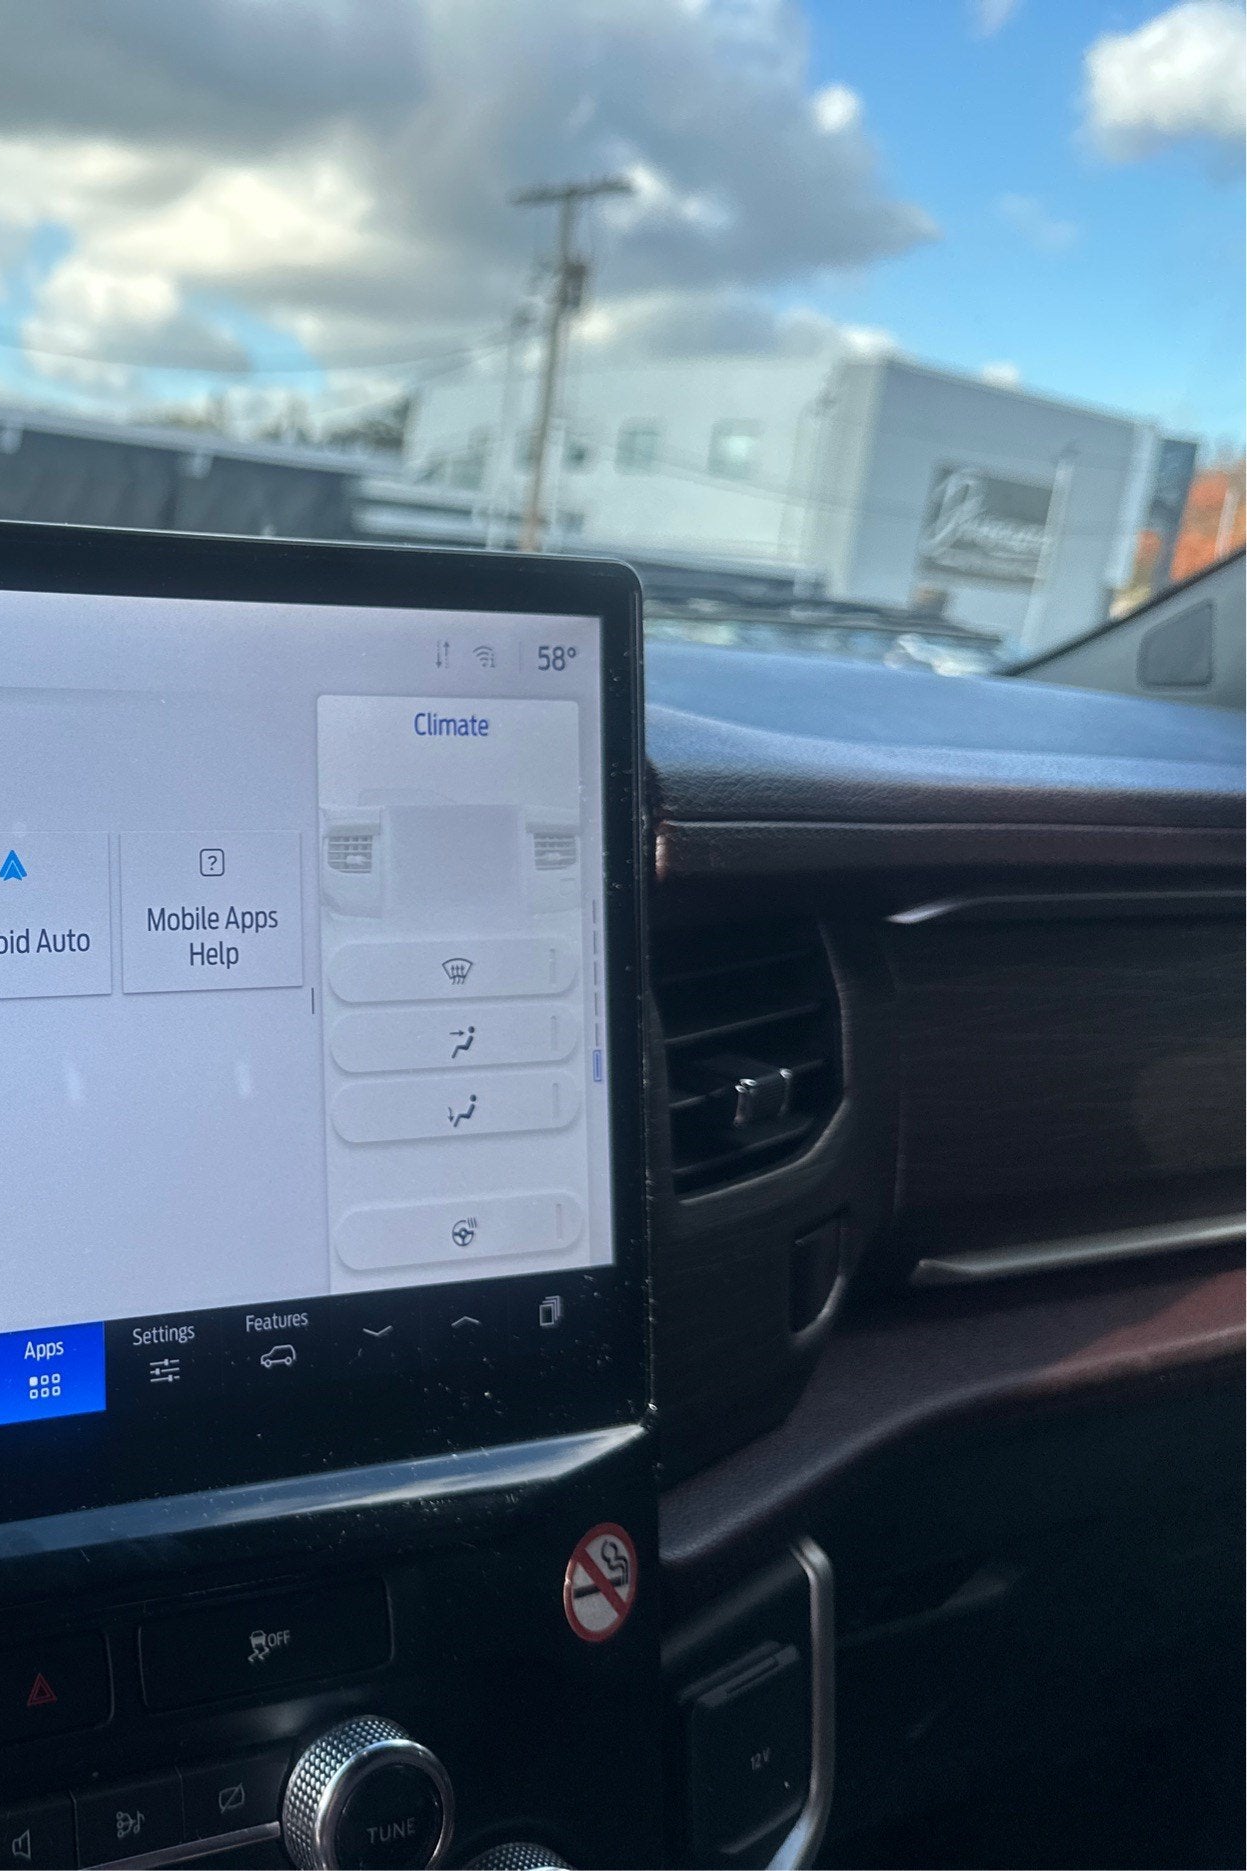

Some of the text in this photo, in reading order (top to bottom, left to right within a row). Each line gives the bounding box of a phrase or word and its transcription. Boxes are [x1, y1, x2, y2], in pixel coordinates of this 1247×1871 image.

[538, 645, 577, 672] 58°
[414, 712, 490, 737] Climate
[147, 905, 279, 934] Mobile Apps
[35, 928, 91, 954] Auto
[189, 940, 240, 970] Help
[245, 1310, 309, 1333] Features
[132, 1325, 196, 1346] Settings
[23, 1341, 65, 1362] Apps
[267, 1629, 291, 1647] OFF
[365, 1816, 417, 1844] TUNE
